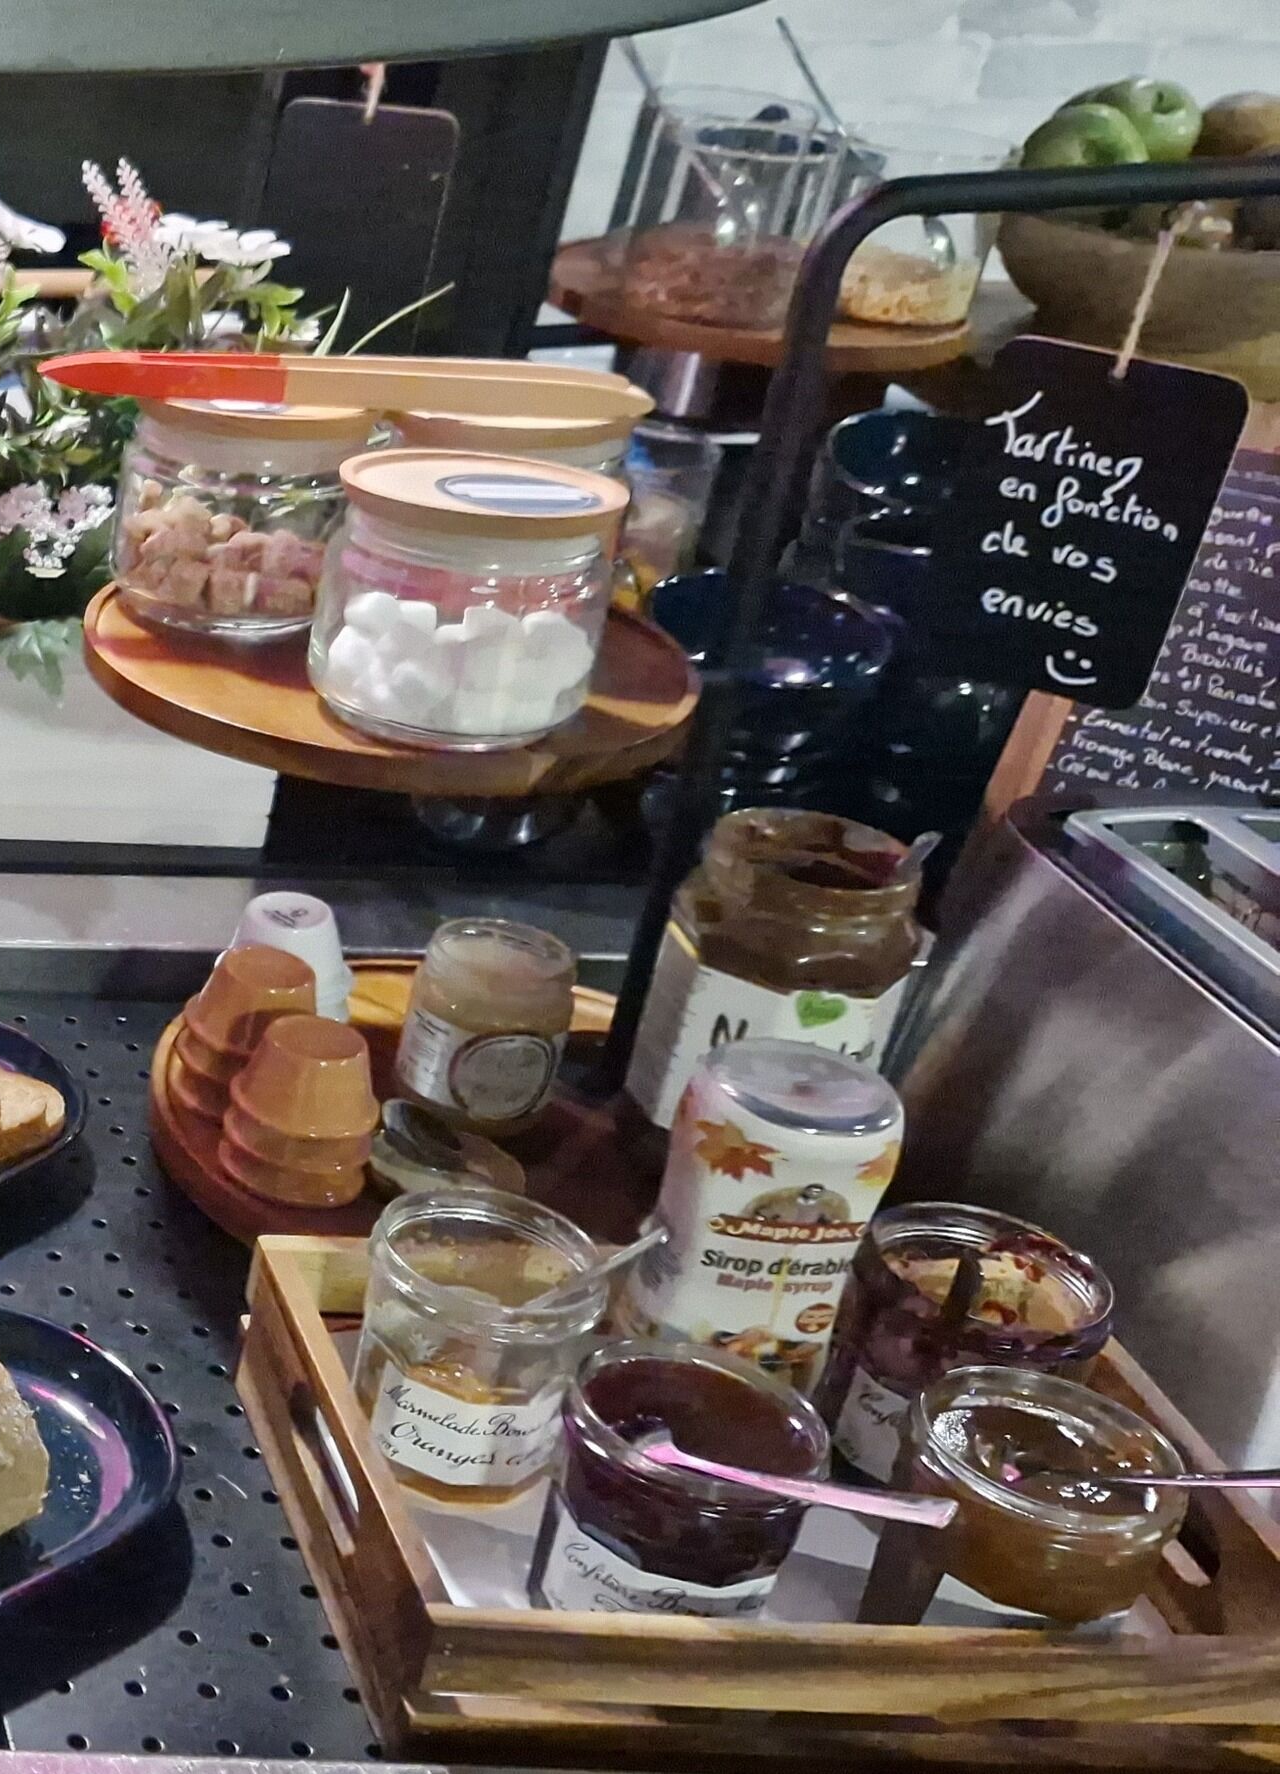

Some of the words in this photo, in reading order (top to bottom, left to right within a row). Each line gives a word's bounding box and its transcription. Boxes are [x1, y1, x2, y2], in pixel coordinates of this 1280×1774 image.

[999, 475, 1036, 502] en
[1041, 477, 1179, 543] fonction
[981, 521, 1029, 558] de
[1051, 544, 1118, 584] vos
[980, 586, 1098, 639] envies
[700, 1249, 763, 1277] Sirop
[716, 1272, 774, 1292] Maple
[384, 1384, 482, 1436] Marmelade
